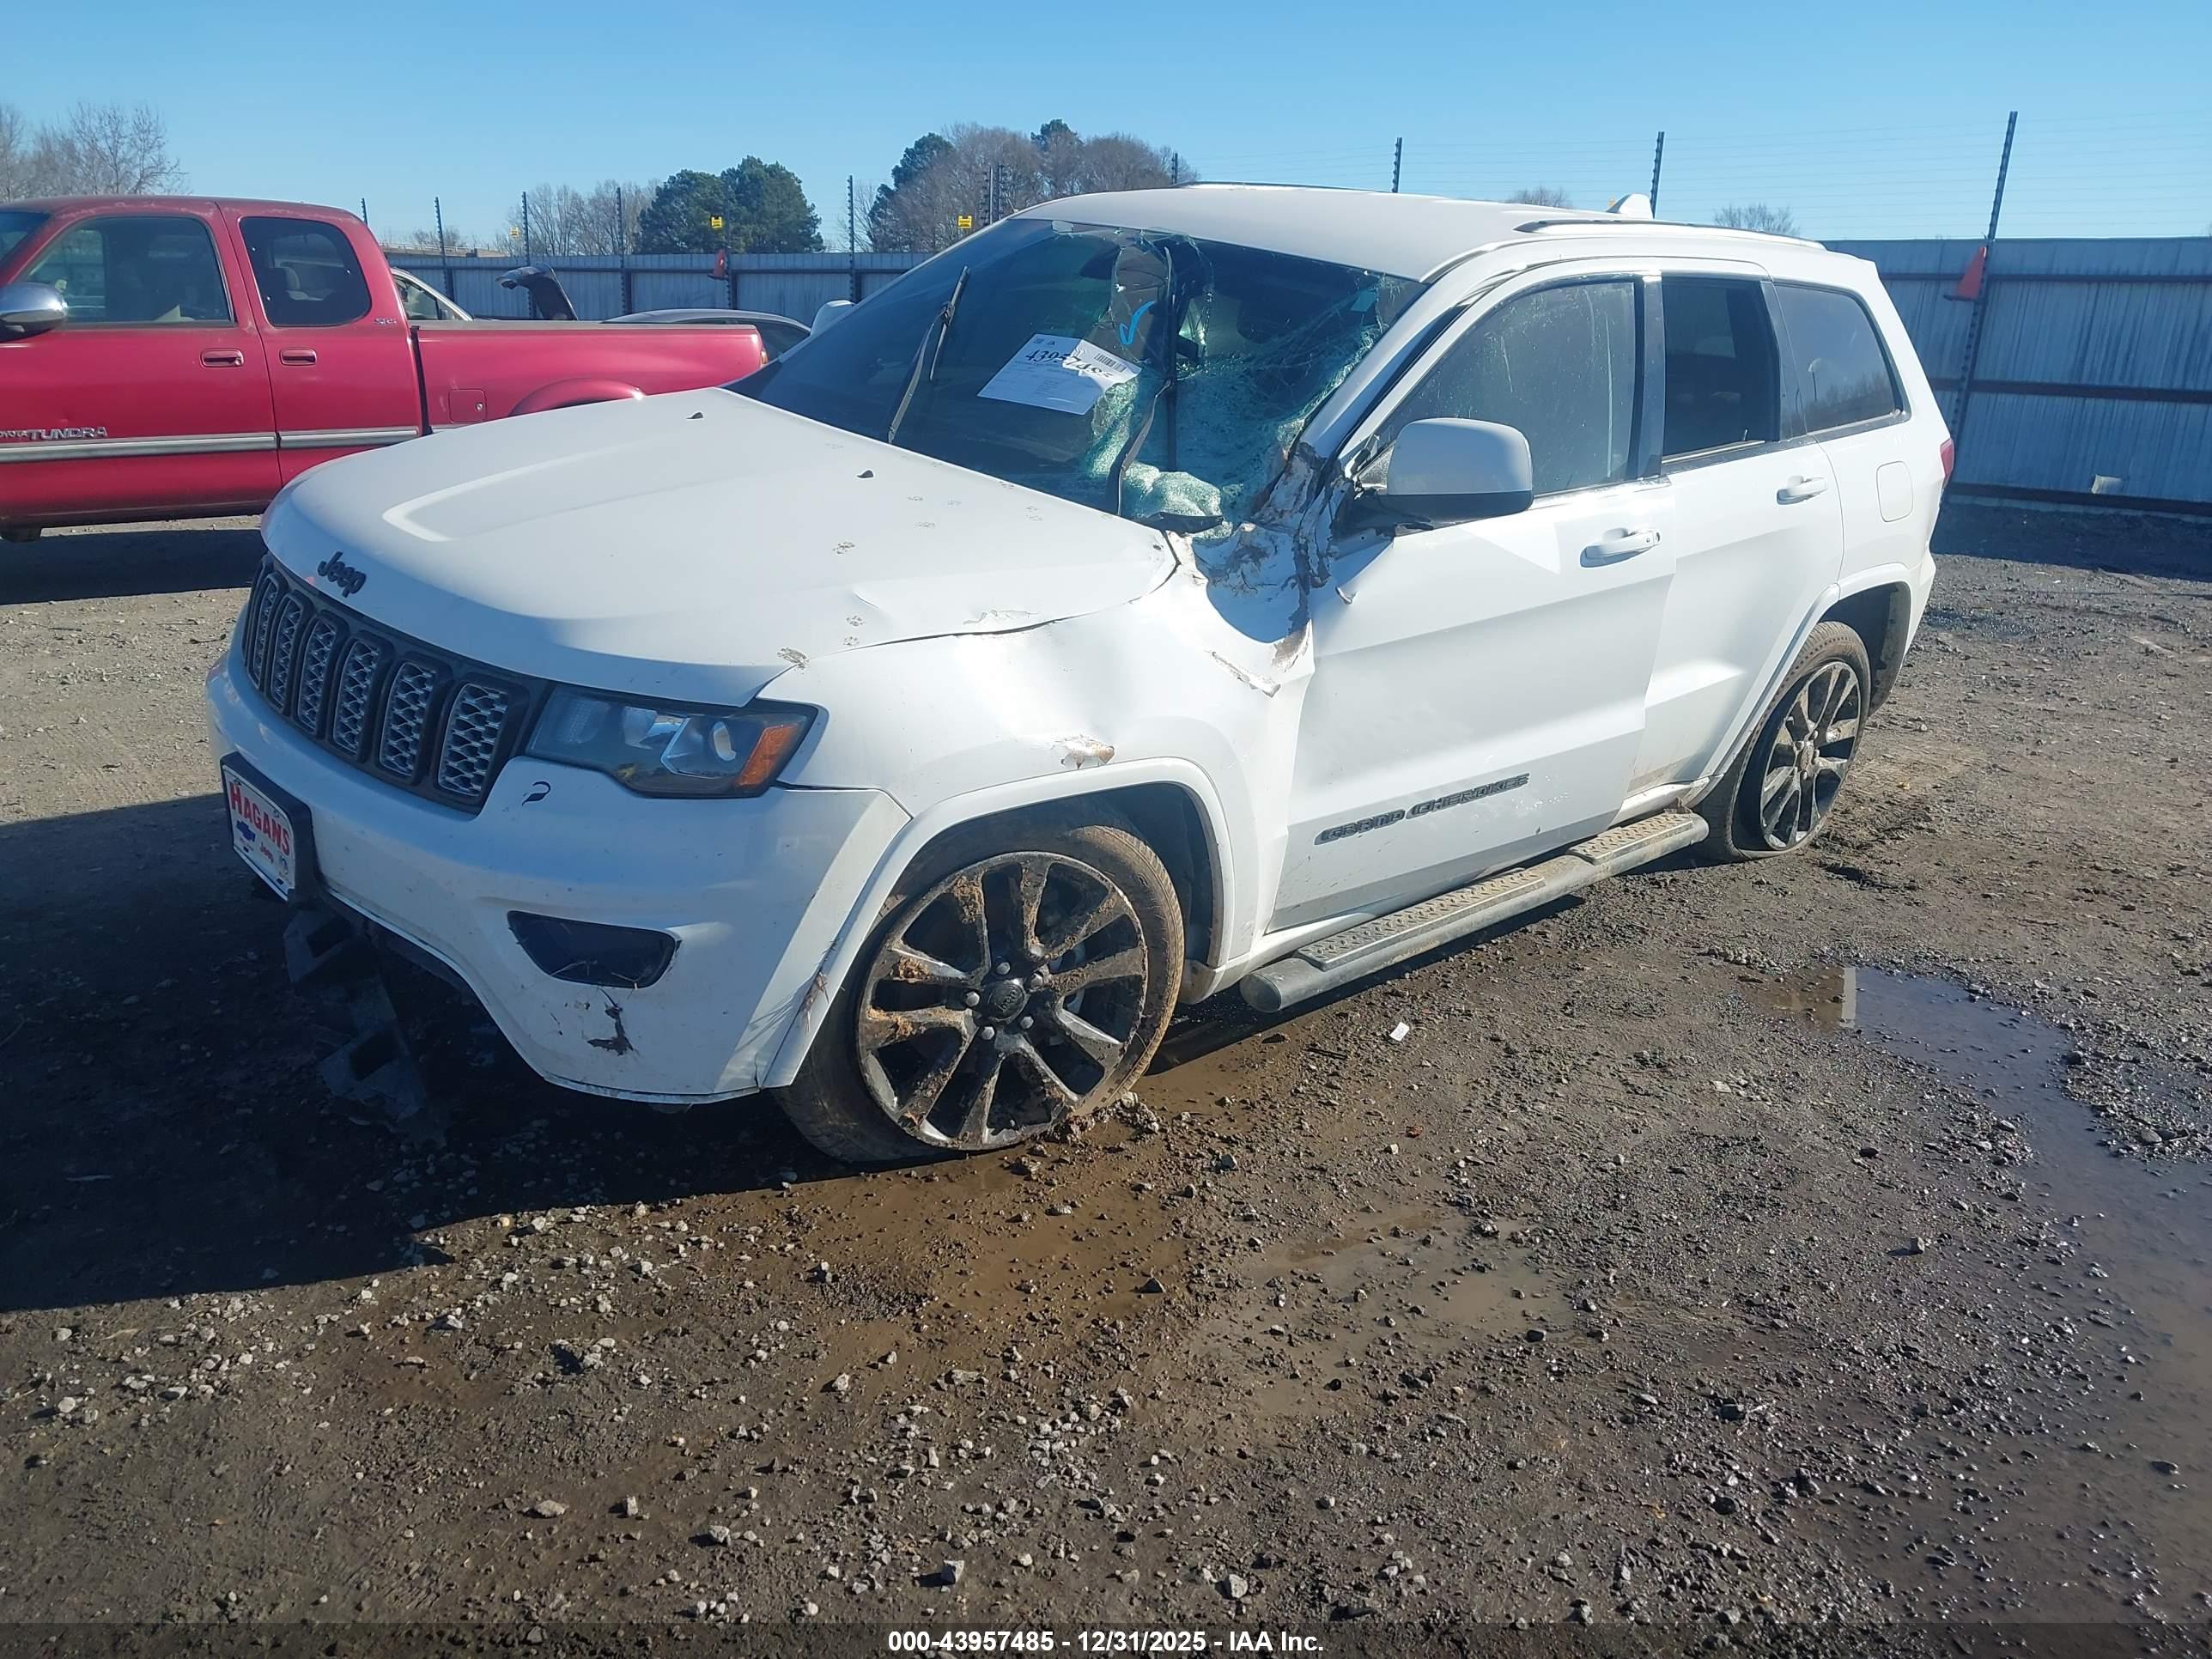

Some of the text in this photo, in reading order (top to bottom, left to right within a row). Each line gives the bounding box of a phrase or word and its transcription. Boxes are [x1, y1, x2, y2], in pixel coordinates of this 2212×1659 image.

[27, 426, 108, 440] TUNDRA
[318, 550, 367, 598] Jeep
[229, 781, 290, 856] HAGANS
[1314, 773, 1530, 845] GRAND CHEROKEE
